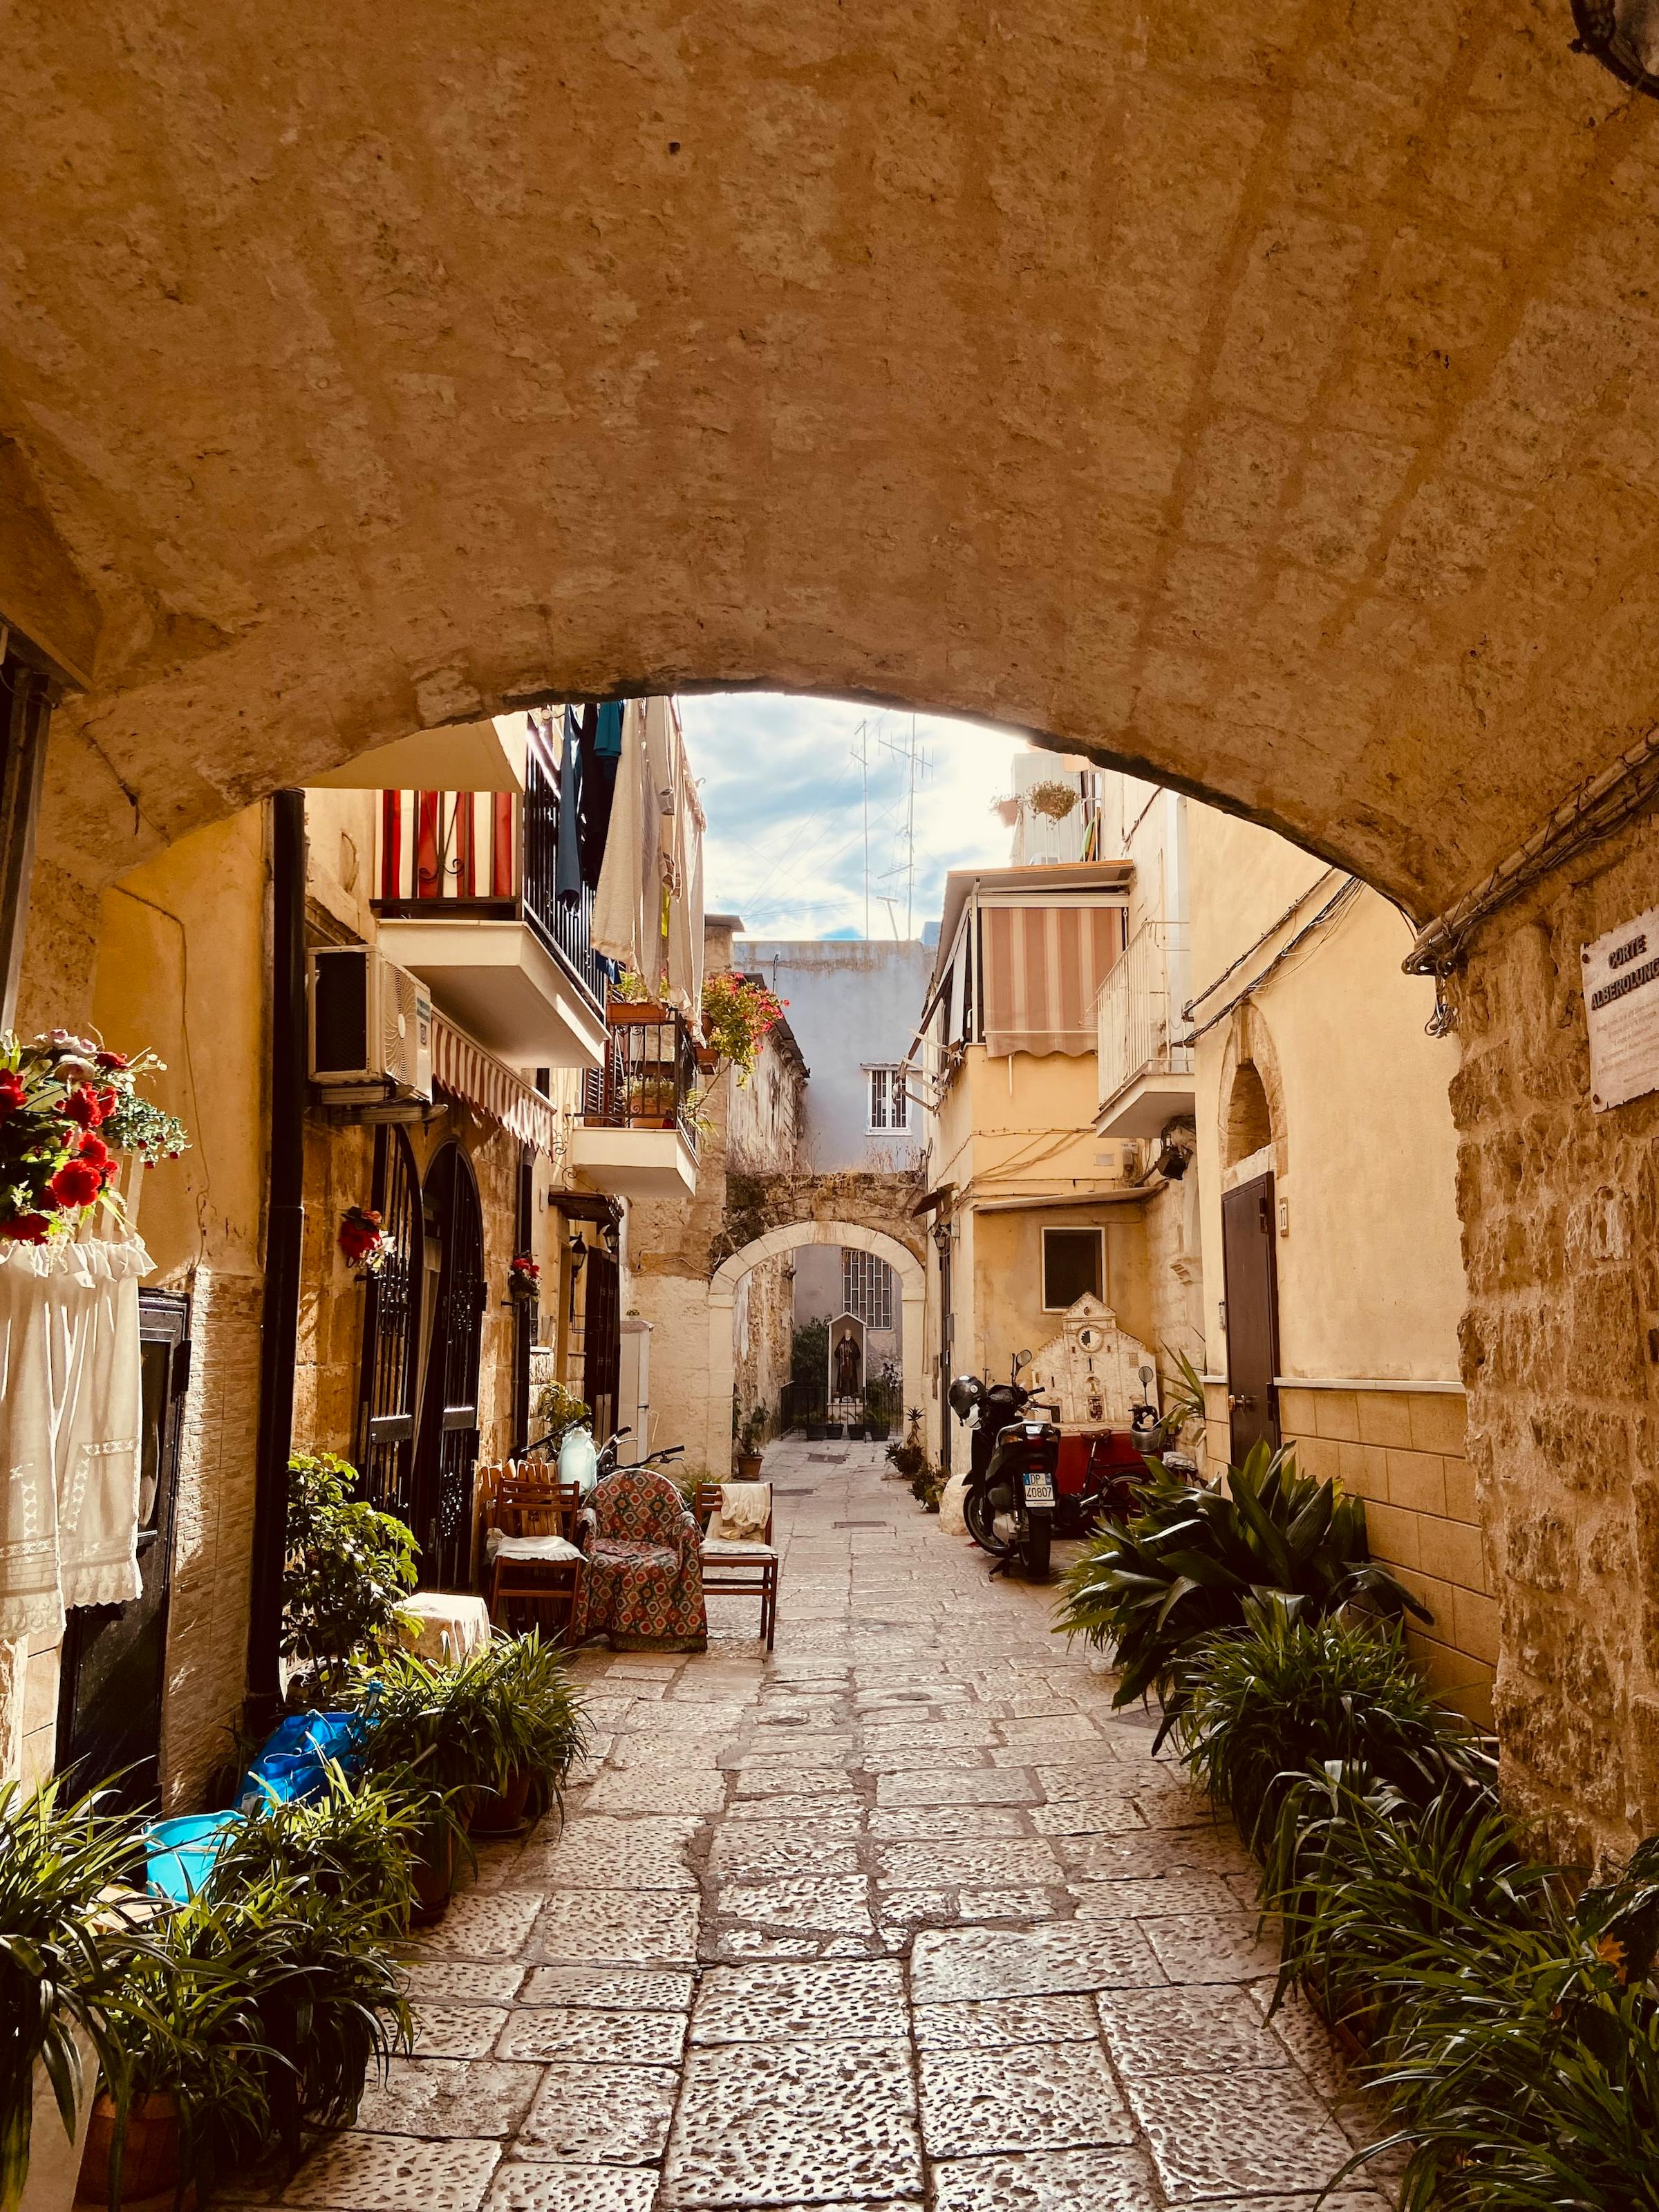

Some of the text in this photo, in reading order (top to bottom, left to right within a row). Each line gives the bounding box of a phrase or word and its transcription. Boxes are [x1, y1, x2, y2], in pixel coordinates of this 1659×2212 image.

[1609, 935, 1647, 969] CORTE
[1030, 1474, 1040, 1485] DP
[1027, 1487, 1051, 1498] 40807
